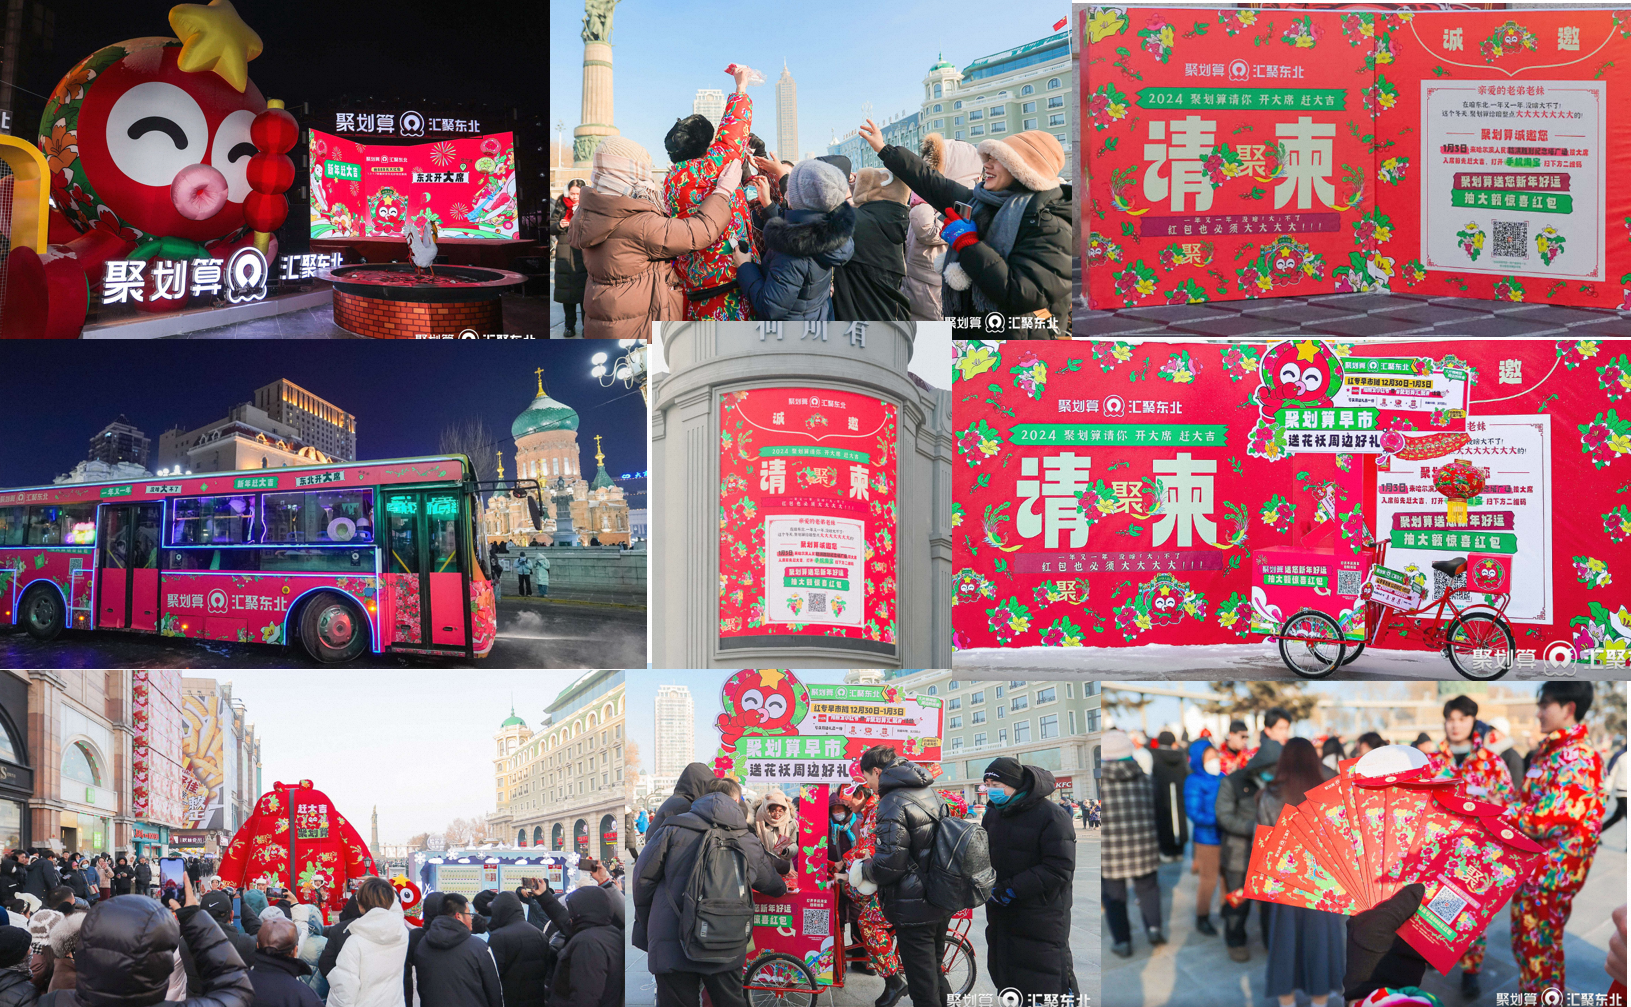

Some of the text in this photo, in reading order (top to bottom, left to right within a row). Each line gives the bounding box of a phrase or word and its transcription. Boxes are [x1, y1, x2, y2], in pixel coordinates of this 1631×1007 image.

[1442, 26, 1580, 52] 诚 邀
[1184, 62, 1304, 79] 聚划算 汇聚东北
[1478, 85, 1545, 96] 亲爱的老弟老妹
[1148, 93, 1335, 106] 2024 聚划算请你 开大席 赶大吉
[336, 112, 480, 133] 聚划算 汇聚东北
[1481, 128, 1548, 142] 聚划算诚邀您
[1442, 144, 1468, 153] 1月3日
[327, 163, 358, 178] 新年赶大吉
[1143, 115, 1217, 212] 请
[416, 170, 464, 182] 东北开大席
[1461, 175, 1562, 188] 聚划算送您新年好运
[1464, 192, 1557, 210] 抽大额惊喜红包
[102, 252, 344, 305] 聚划算 汇聚东北
[1380, 362, 1409, 371] 汇聚东北
[1498, 358, 1522, 386] 邀
[1058, 398, 1182, 414] 聚划算 汇聚东北
[1284, 410, 1373, 429] 聚划算早市
[1020, 430, 1216, 442] 2024 聚划算请你 开大席 赶大吉
[1288, 433, 1380, 448] 送花袄周边好礼
[300, 472, 341, 486] 东北开大席
[760, 458, 786, 494] 请
[1381, 483, 1406, 492] 1月3日
[1016, 452, 1092, 548] 请
[1404, 532, 1501, 549] 抽大额惊喜红包
[1268, 576, 1323, 586] 抽大额惊喜红包
[166, 593, 288, 612] 聚划算 汇聚东北
[811, 688, 880, 698] 聚划算 汇聚东北
[850, 706, 904, 716] 12月30日-1月3日
[746, 738, 841, 758] 聚划算早市
[750, 762, 849, 778] 送花袄周边好礼
[298, 804, 328, 814] 赶大吉
[298, 828, 329, 838] 聚划算
[754, 904, 792, 913] 您新年好运
[754, 915, 788, 926] 惊喜红包
